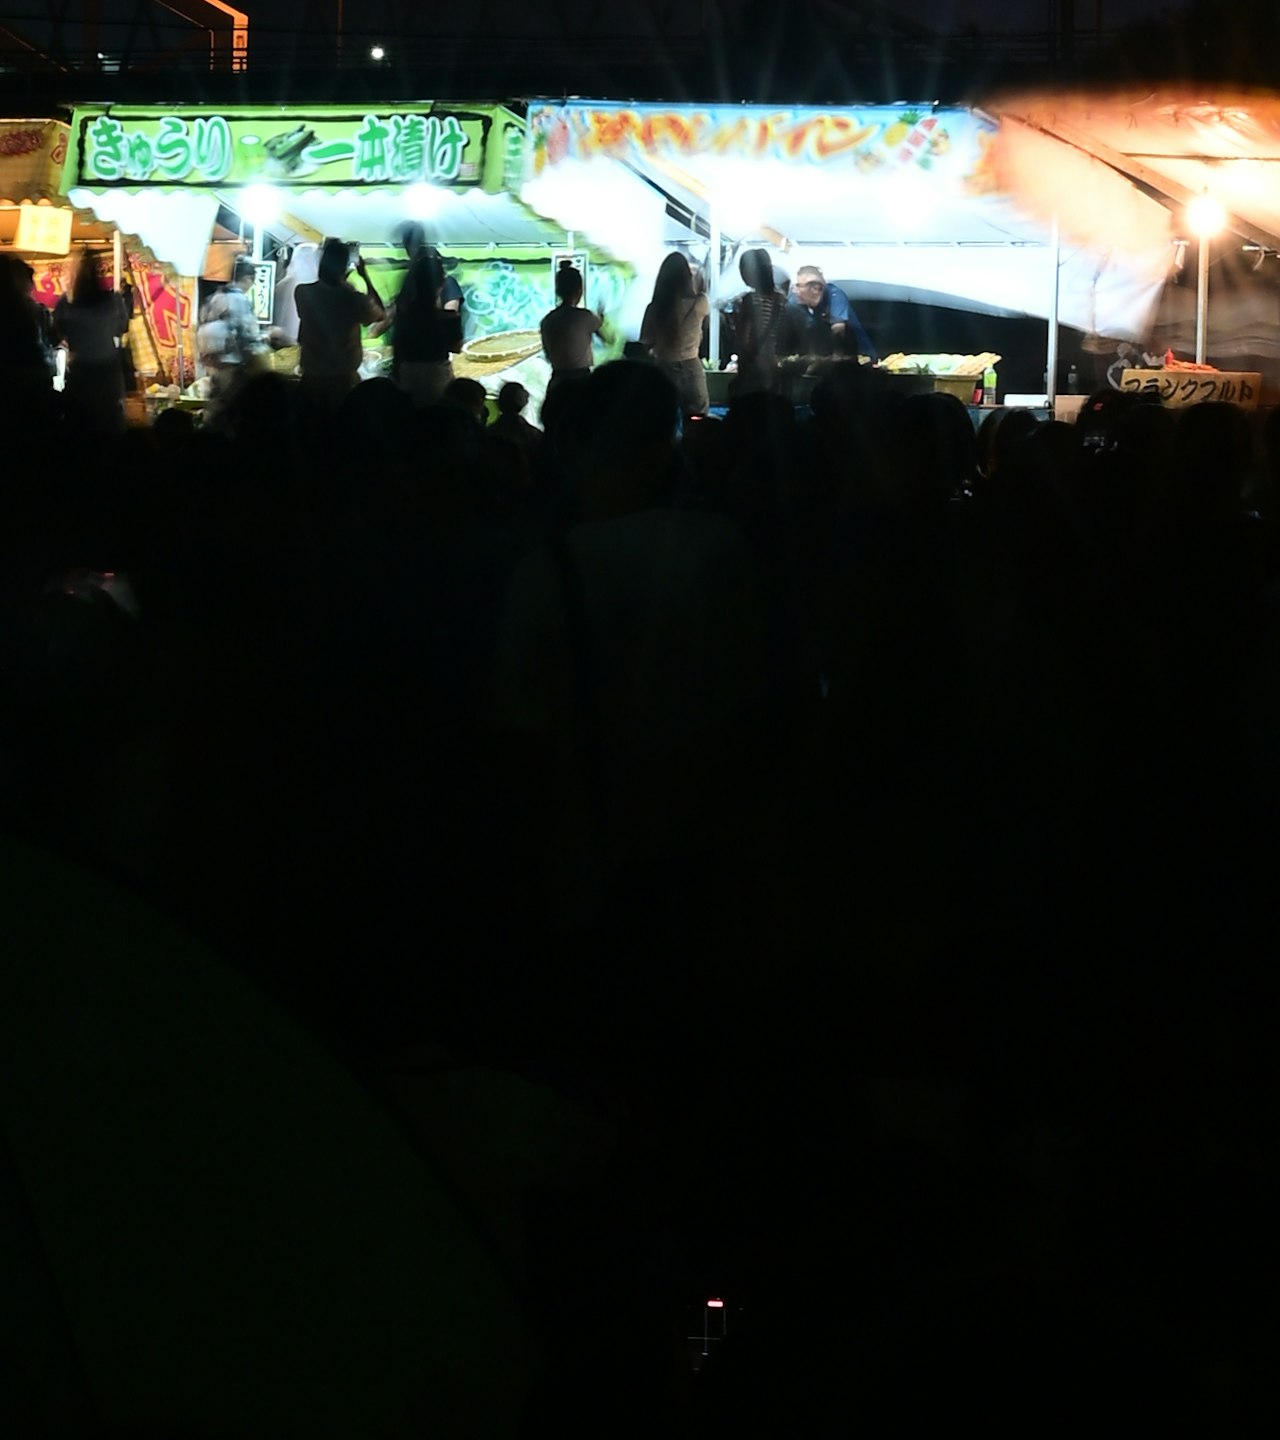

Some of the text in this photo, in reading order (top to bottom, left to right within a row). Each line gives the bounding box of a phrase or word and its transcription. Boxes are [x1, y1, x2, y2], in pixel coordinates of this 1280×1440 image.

[90, 116, 231, 180] きゅうり
[303, 114, 468, 180] 一本漬け
